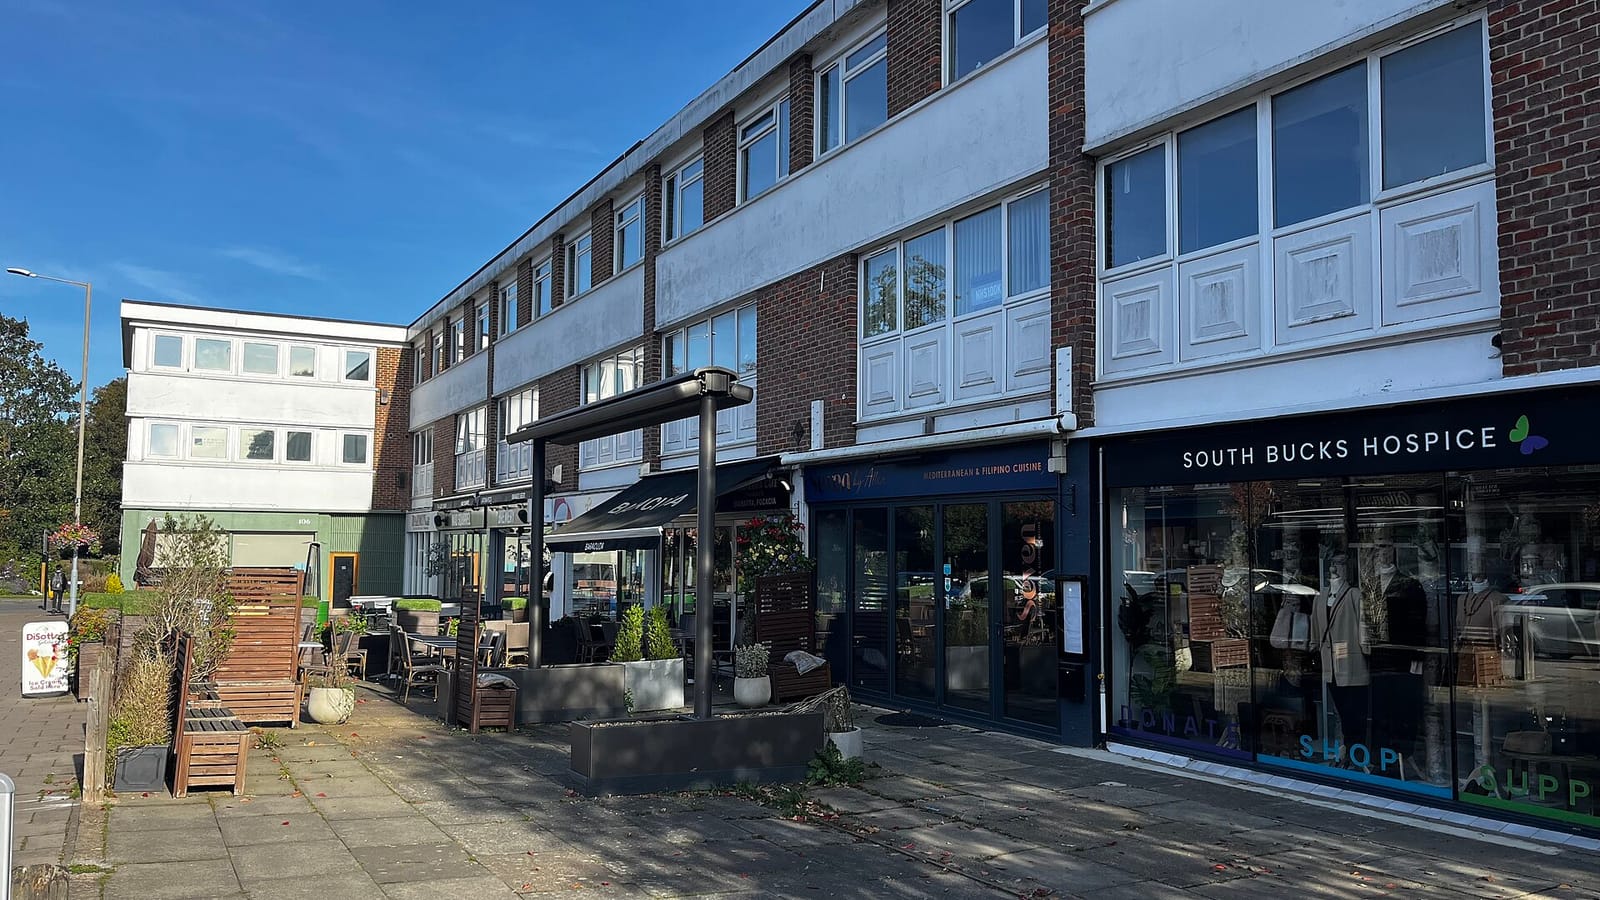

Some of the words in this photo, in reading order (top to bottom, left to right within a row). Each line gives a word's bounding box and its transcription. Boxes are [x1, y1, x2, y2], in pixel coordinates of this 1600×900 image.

[1183, 447, 1254, 469] SOUTH
[1266, 439, 1348, 463] BUCKS
[1363, 426, 1497, 457] HOSPICE
[922, 467, 974, 480] MEDITERRANEAN
[981, 465, 1011, 475] FILIPINO
[1012, 461, 1042, 473] CUISINE
[1120, 704, 1240, 746] DONATE
[1299, 733, 1398, 772] SHOP
[1479, 763, 1591, 807] SUPP
